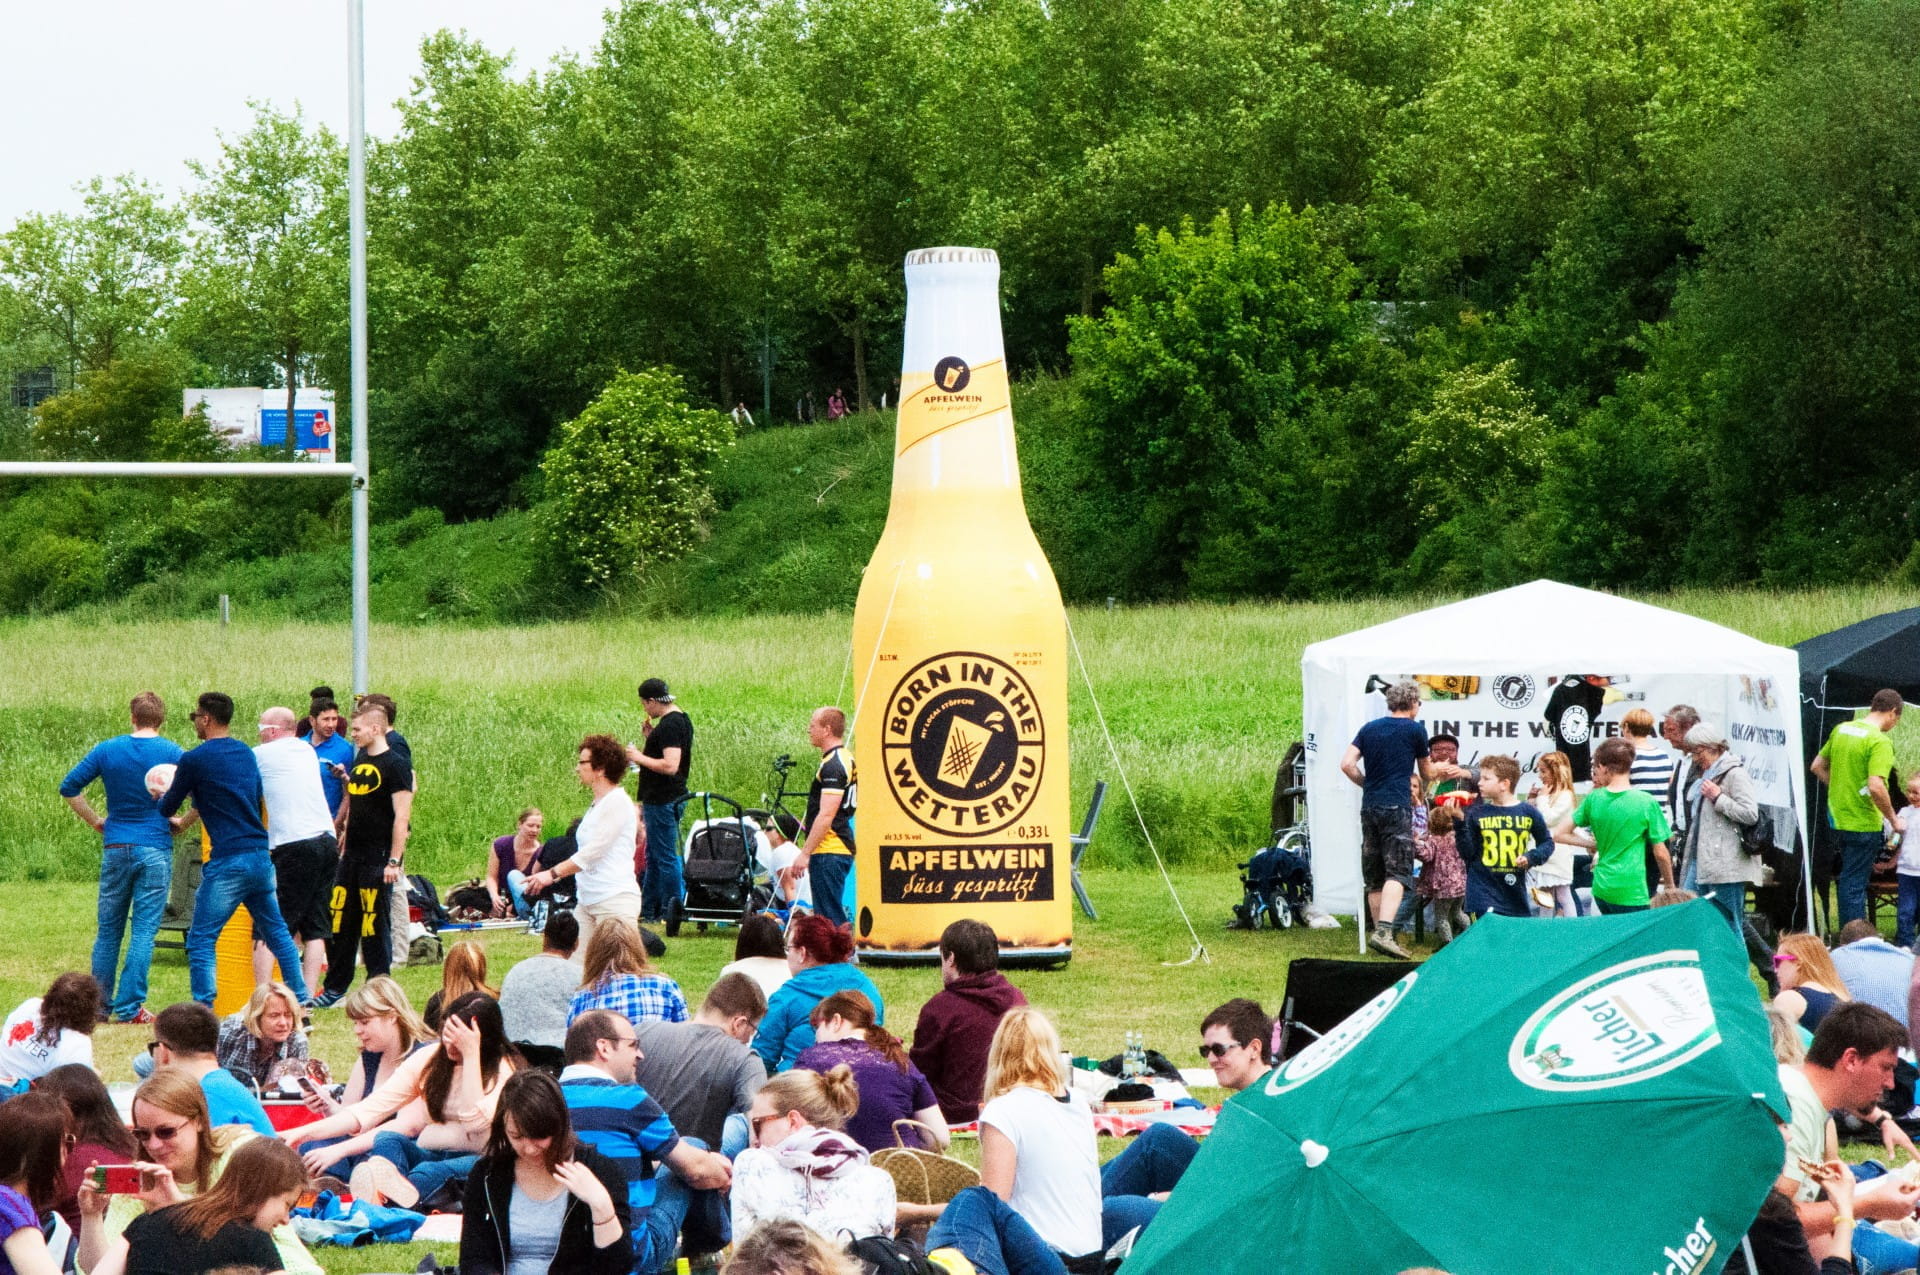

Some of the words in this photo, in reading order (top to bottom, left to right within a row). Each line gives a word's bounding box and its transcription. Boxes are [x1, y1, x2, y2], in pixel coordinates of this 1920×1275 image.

[923, 395, 982, 404] APFELWEIN
[890, 664, 952, 736] BORN
[961, 662, 994, 686] IN
[999, 676, 1038, 734] THE
[1433, 719, 1460, 738] IN
[1468, 720, 1519, 738] THE
[893, 755, 1037, 827] WETTERAU
[1018, 825, 1043, 840] 0,33
[1479, 815, 1513, 829] THAT'S
[889, 848, 1046, 871] APFELWEIN
[950, 871, 1038, 902] gespritzt
[1582, 999, 1666, 1064] Licher
